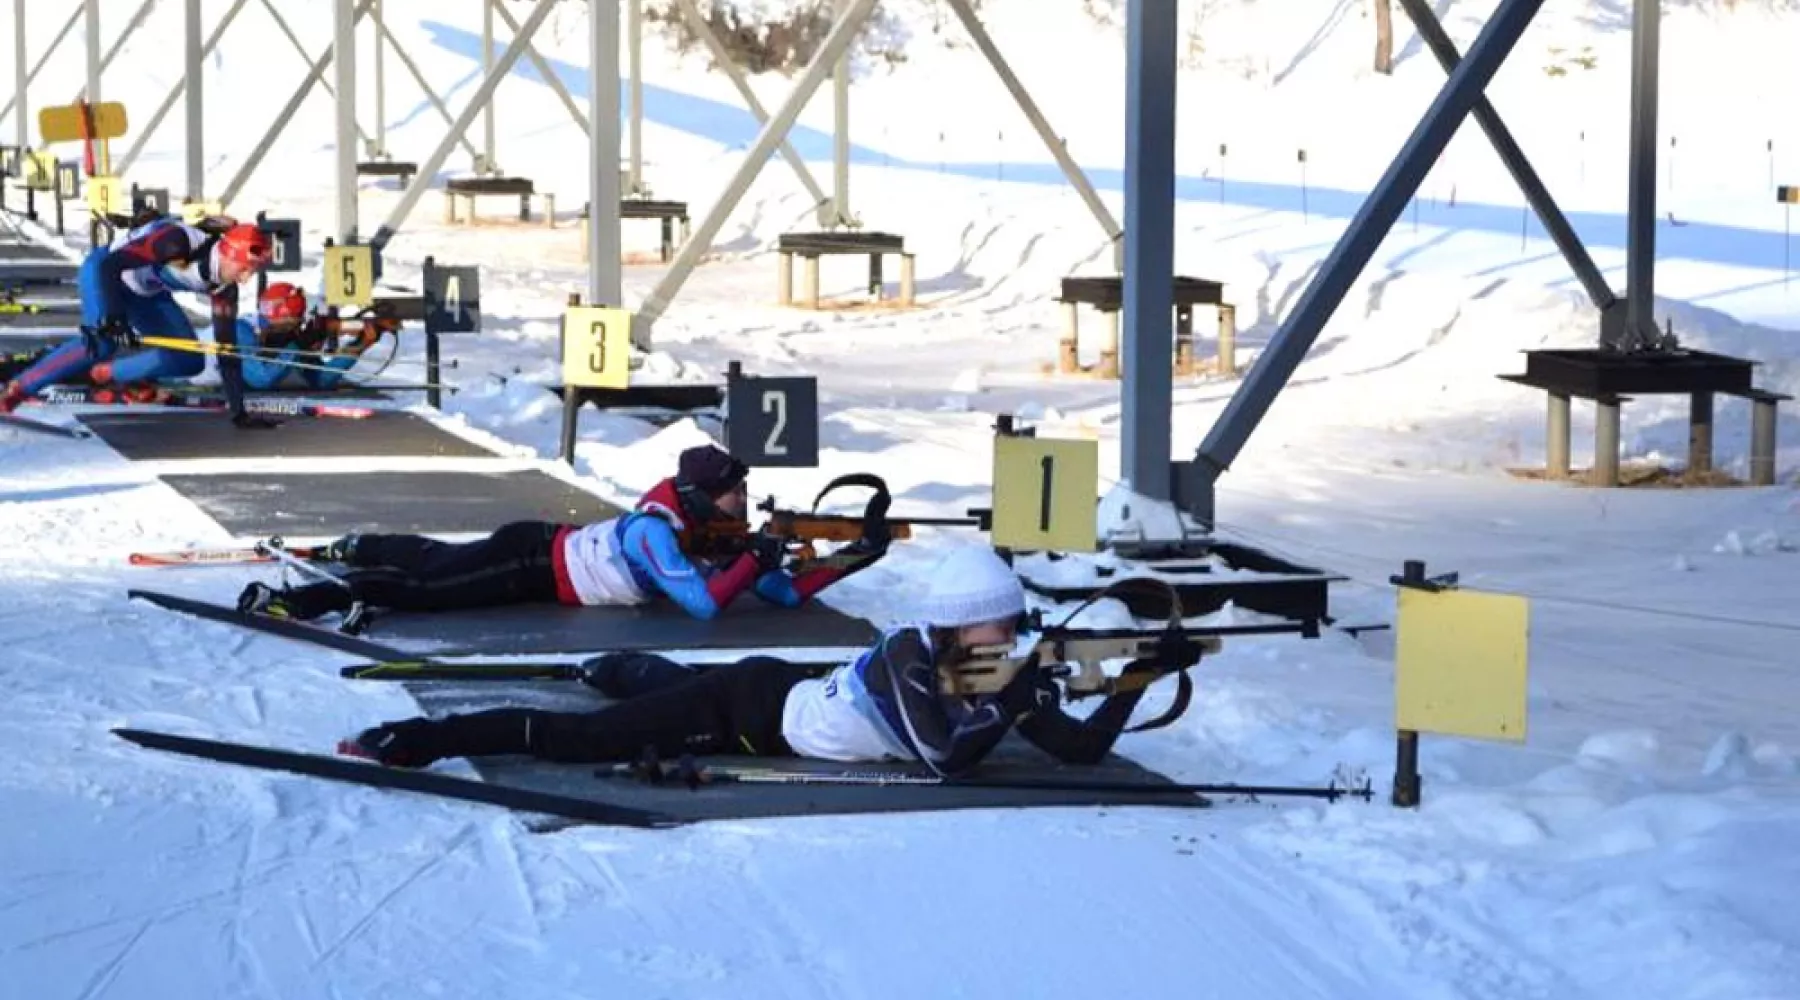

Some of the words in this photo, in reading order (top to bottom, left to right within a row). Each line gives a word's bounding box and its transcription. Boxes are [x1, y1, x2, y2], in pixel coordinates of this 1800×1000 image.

[272, 232, 285, 265] 6
[342, 256, 356, 297] 5
[446, 275, 460, 324] 4
[589, 321, 606, 374] 3
[762, 390, 788, 455] 2
[1041, 455, 1053, 531] 1
